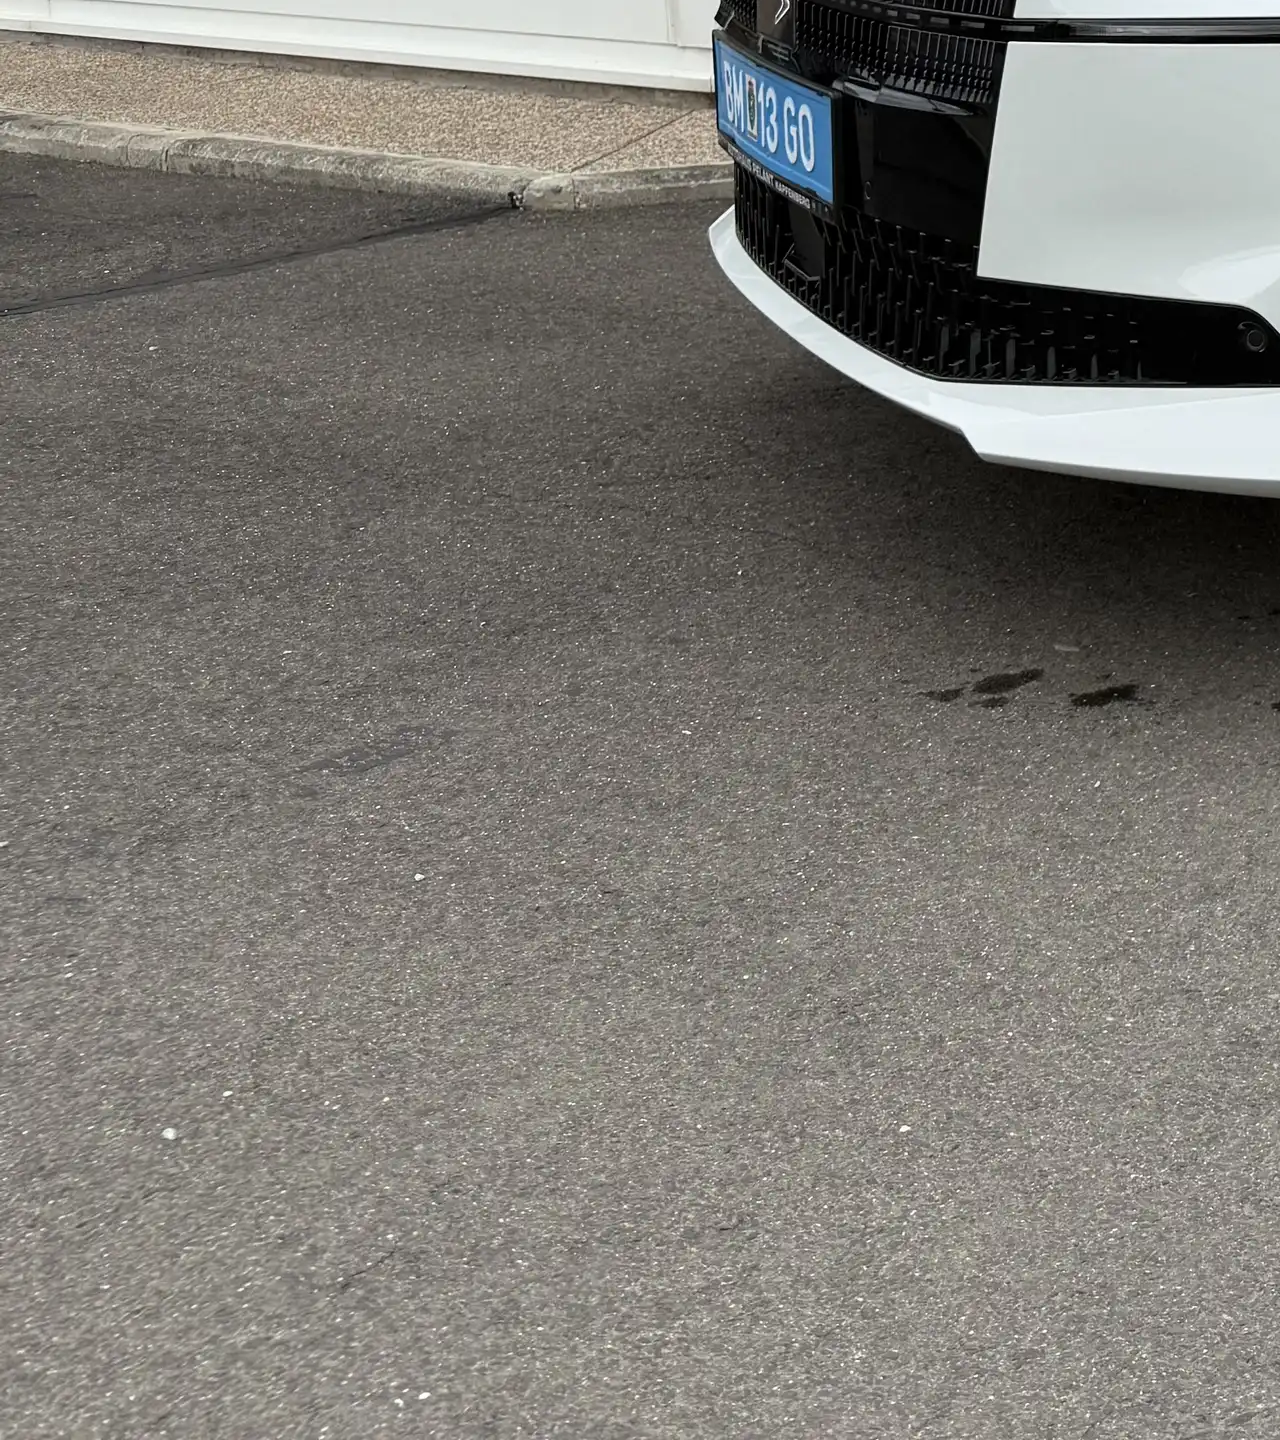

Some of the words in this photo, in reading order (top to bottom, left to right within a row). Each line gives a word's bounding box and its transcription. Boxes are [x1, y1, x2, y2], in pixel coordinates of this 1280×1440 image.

[724, 61, 745, 133] BM
[758, 81, 779, 154] 13
[783, 96, 815, 173] GO
